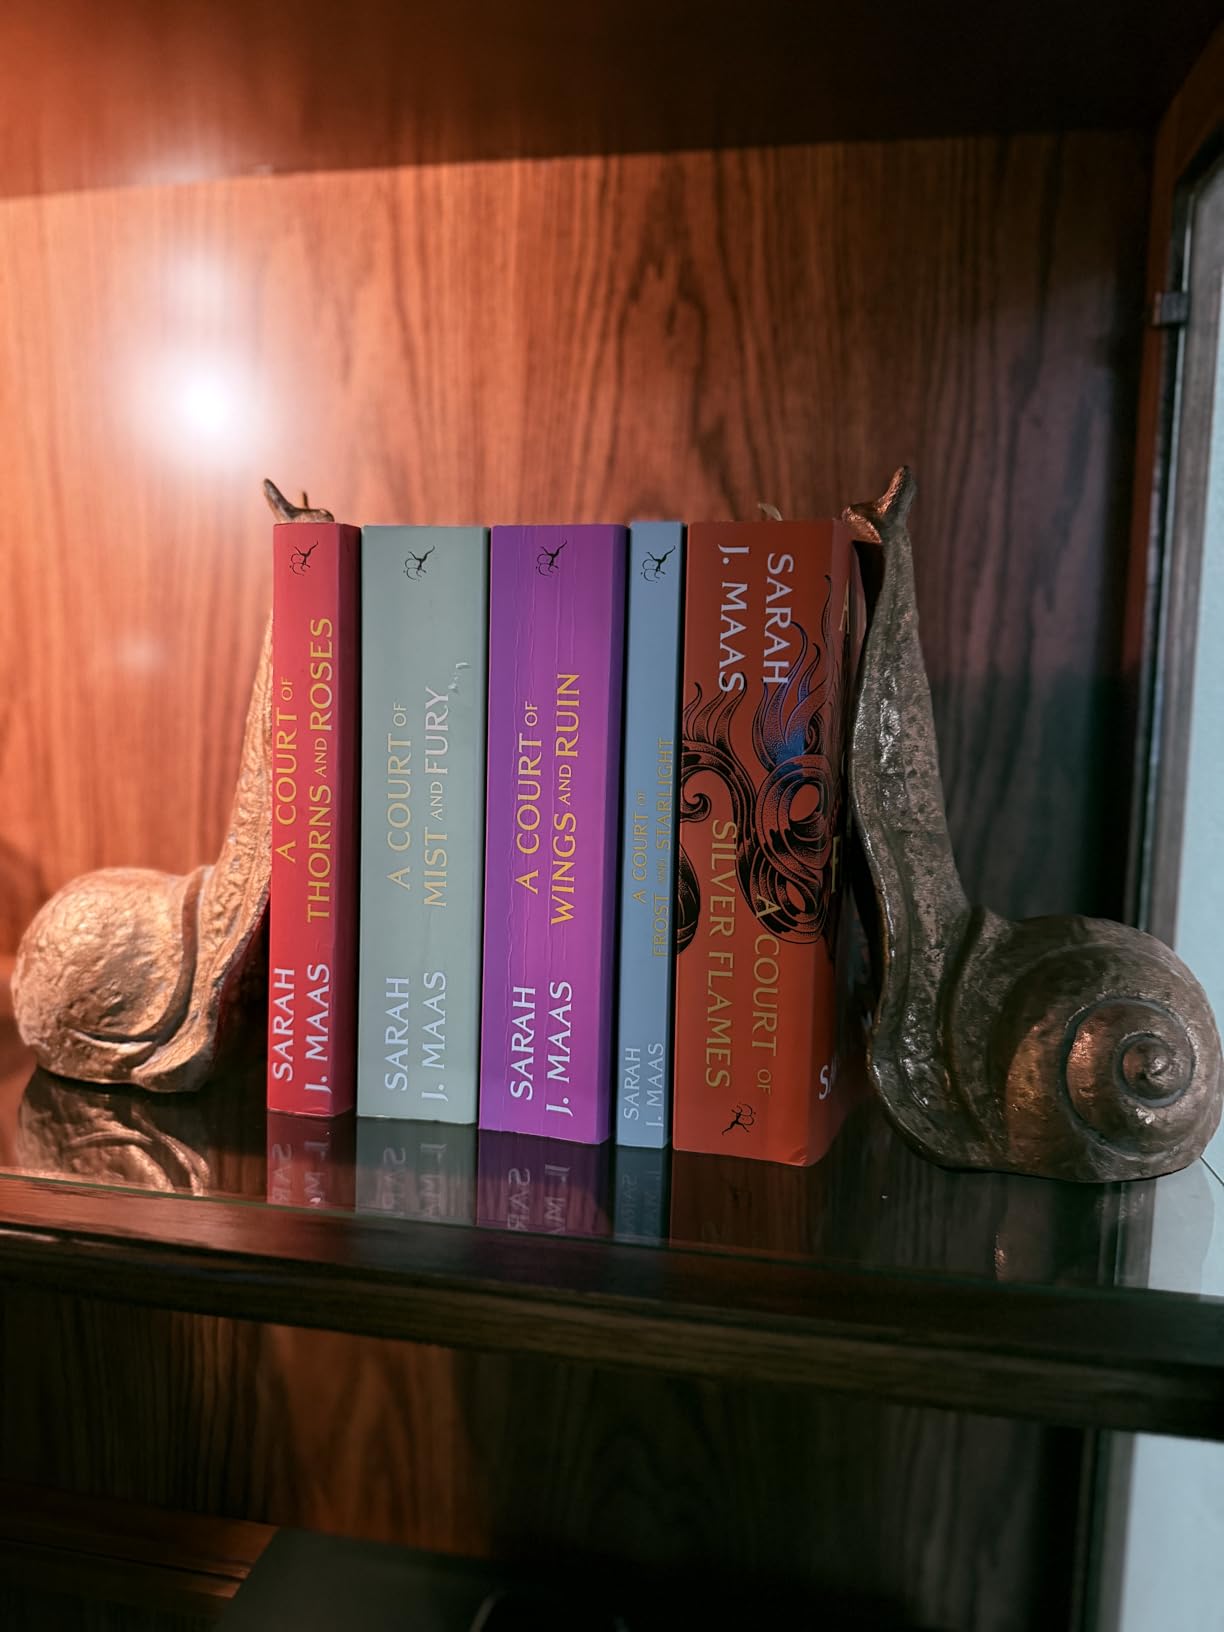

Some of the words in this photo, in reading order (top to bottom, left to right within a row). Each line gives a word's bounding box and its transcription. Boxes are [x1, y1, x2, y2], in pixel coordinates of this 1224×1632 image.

[717, 544, 750, 565] J.
[718, 581, 748, 693] MAAS
[762, 553, 794, 685] SARAH
[281, 677, 294, 702] OF
[310, 618, 334, 731] ROSES
[524, 701, 538, 727] OF
[393, 703, 408, 727] OF
[425, 687, 449, 775] FURY
[555, 674, 580, 757] RUIN
[275, 711, 298, 826] COURT
[314, 737, 328, 778] AND
[387, 733, 412, 852] COURT
[516, 733, 542, 854] COURT
[558, 764, 572, 806] AND
[656, 737, 674, 850] STARLIGHT
[430, 781, 443, 820] AND
[275, 841, 297, 864] A
[307, 785, 333, 923] THORNS
[386, 866, 411, 890] A
[424, 827, 448, 907] MIST
[515, 870, 539, 895] A
[550, 812, 577, 925] WINGS
[632, 812, 649, 882] COURT
[708, 819, 737, 937] SILVER
[632, 889, 648, 904] A
[652, 893, 670, 957] FROST
[755, 895, 781, 919] A
[272, 968, 296, 1082] SARAH
[305, 963, 330, 1061] MAAS
[385, 977, 410, 1091] SARAH
[421, 972, 447, 1070] MAAS
[546, 981, 573, 1083] MAAS
[705, 951, 734, 1089] FLAMES
[751, 934, 780, 1057] COURT
[510, 986, 536, 1101] SARAH
[646, 1043, 664, 1107] MAAS
[756, 1068, 772, 1095] OF
[304, 1076, 333, 1094] J.
[421, 1084, 449, 1102] J.
[545, 1097, 573, 1117] J.
[623, 1047, 641, 1121] SARAH
